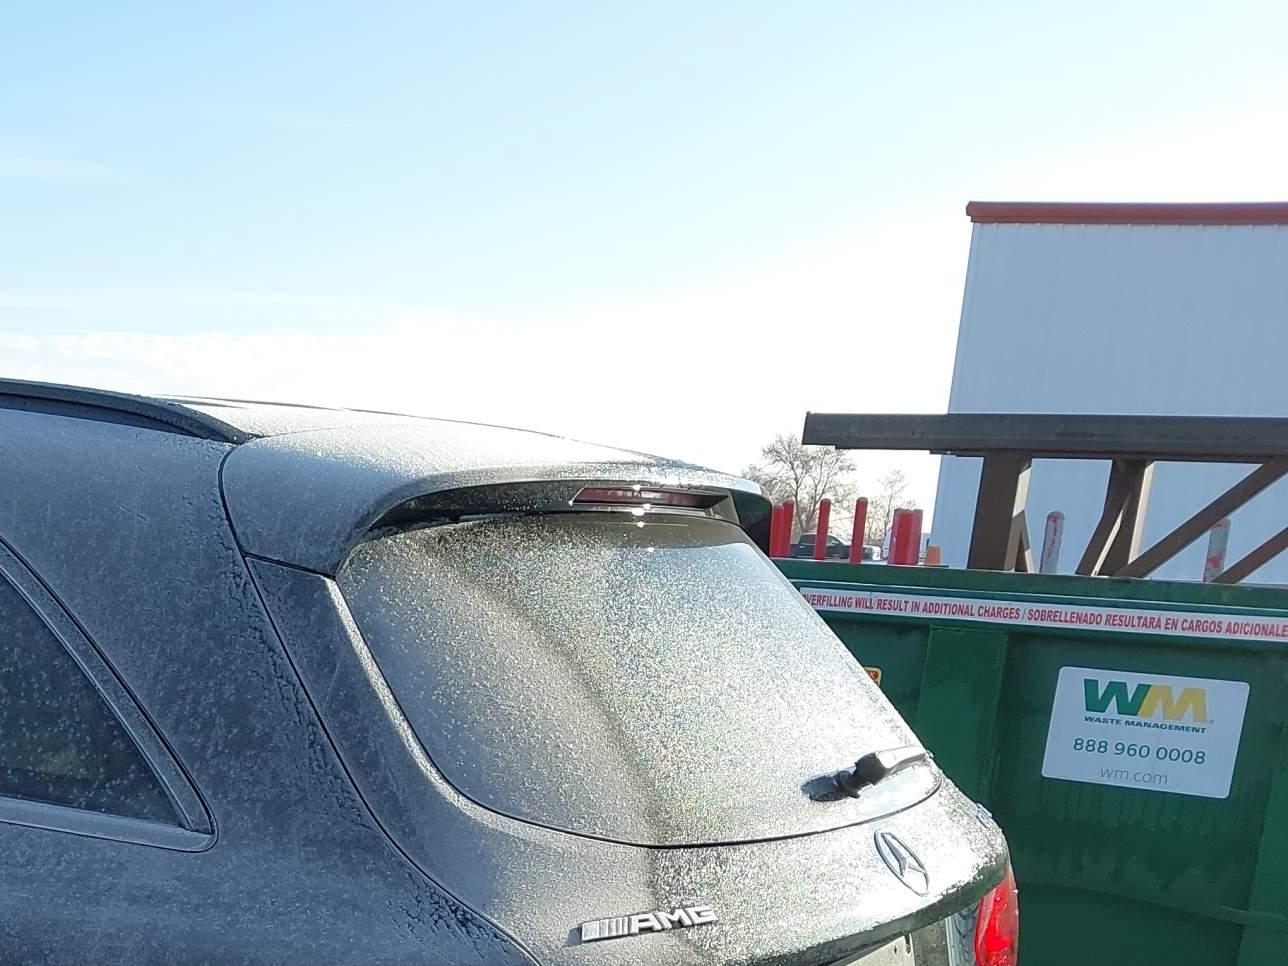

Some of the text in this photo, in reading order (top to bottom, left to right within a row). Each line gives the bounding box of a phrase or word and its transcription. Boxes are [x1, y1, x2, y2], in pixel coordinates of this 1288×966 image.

[855, 596, 874, 610] WILL
[876, 598, 909, 613] RESULT
[910, 600, 920, 613] IN
[922, 601, 975, 617] ADDITIONAL
[977, 605, 1020, 620] CHARGES
[1028, 608, 1102, 625] SOBRELLENADO
[1164, 618, 1179, 631] EN
[1181, 619, 1223, 633] CARGOS
[1083, 678, 1208, 723] WM
[1084, 715, 1207, 734] WASTE MANAGEMENT
[1073, 737, 1206, 764] 888 960 0008
[1100, 767, 1168, 785] wm.com
[629, 905, 718, 934] AMG
